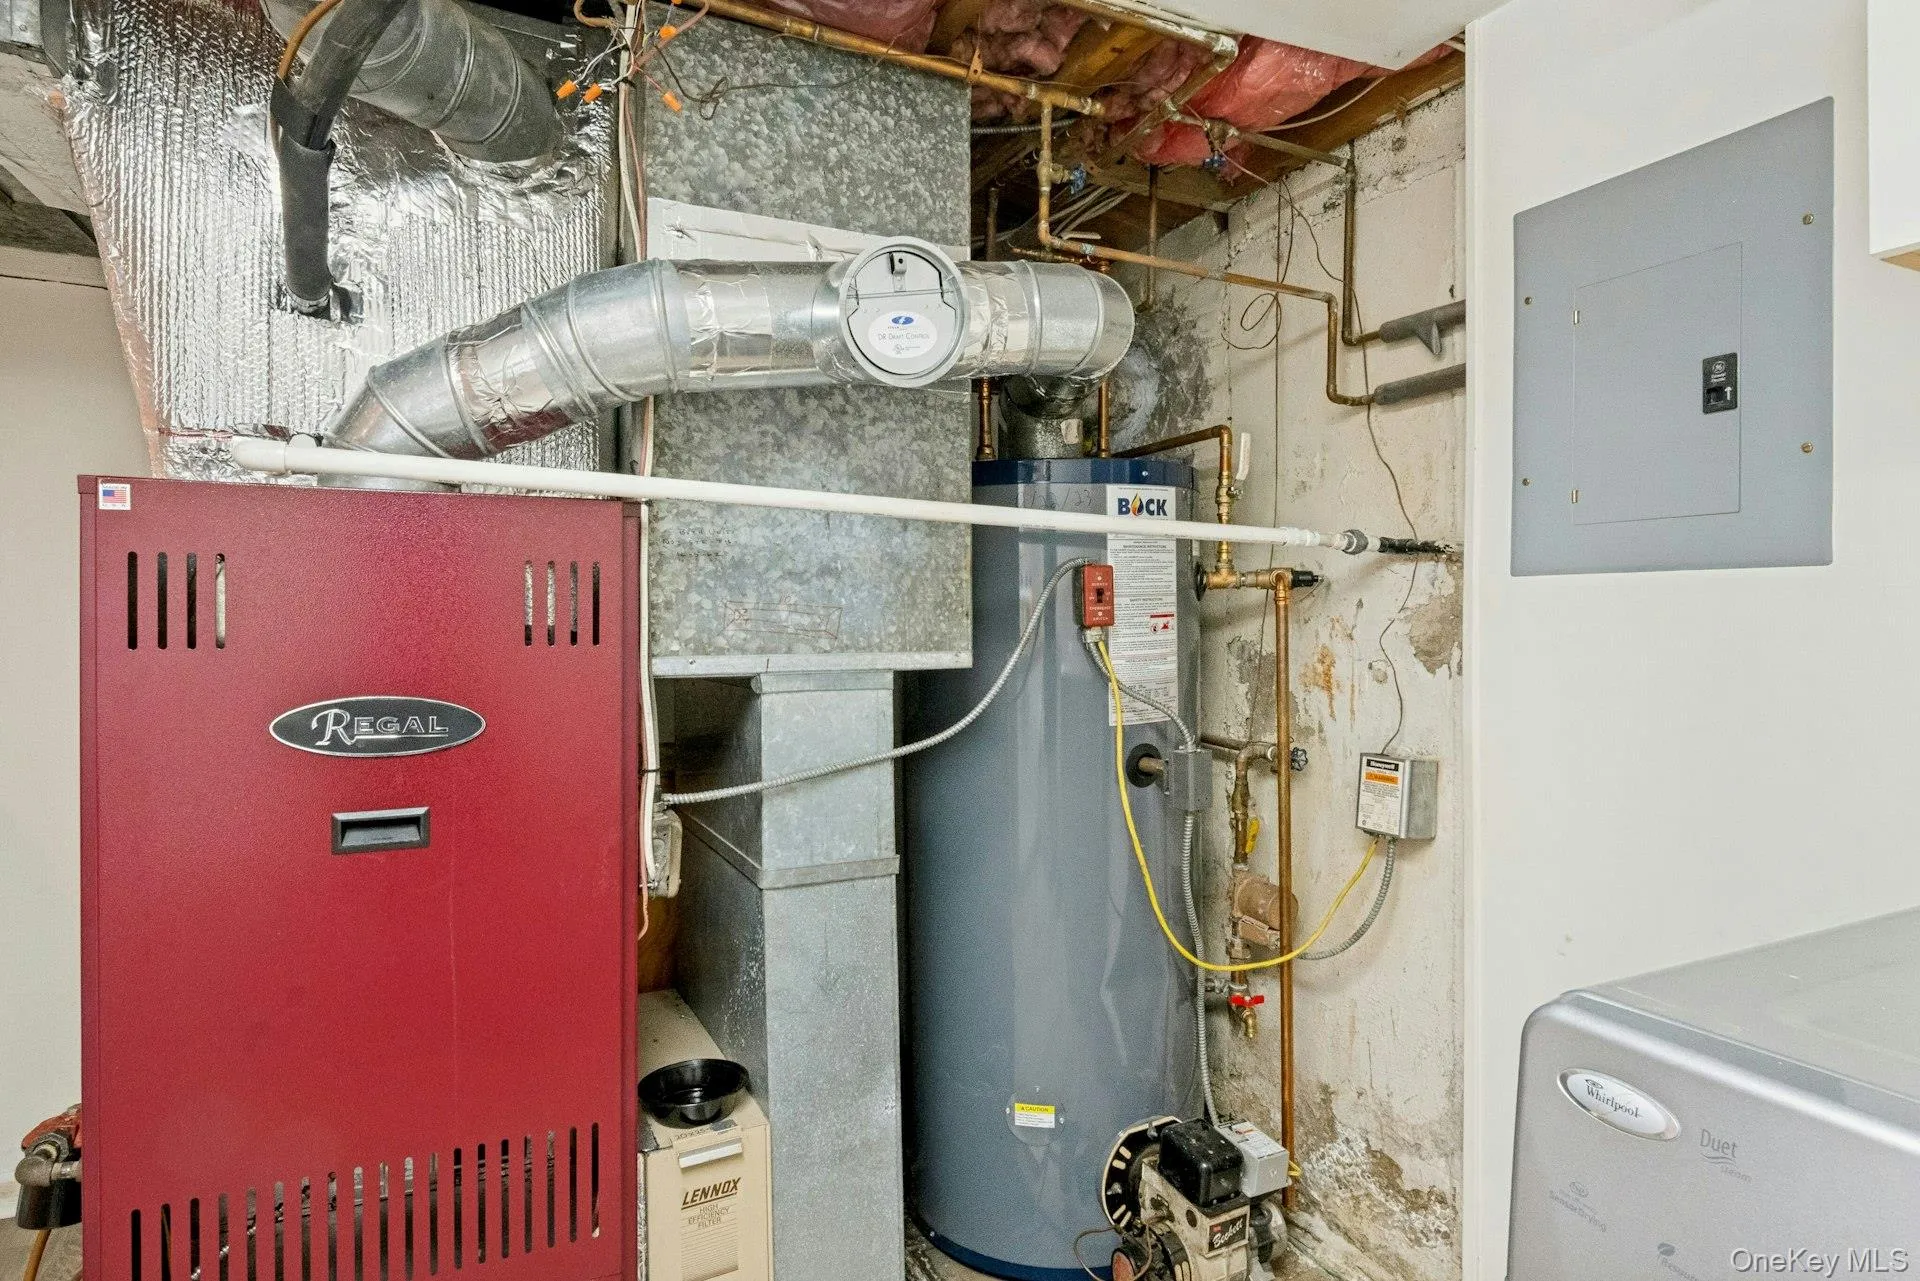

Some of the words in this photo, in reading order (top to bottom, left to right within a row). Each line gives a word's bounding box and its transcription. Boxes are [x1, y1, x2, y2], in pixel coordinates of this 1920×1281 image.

[1117, 493, 1168, 516] BOCK
[311, 708, 449, 746] REGAL
[1585, 1085, 1642, 1119] Whirlpool
[1700, 1128, 1738, 1158] Duet
[682, 1177, 741, 1206] LENNOX
[688, 1206, 730, 1226] EFFICIENCY
[697, 1217, 722, 1229] FILTER
[700, 1203, 719, 1214] HIGH
[1212, 1218, 1244, 1248] Beckett
